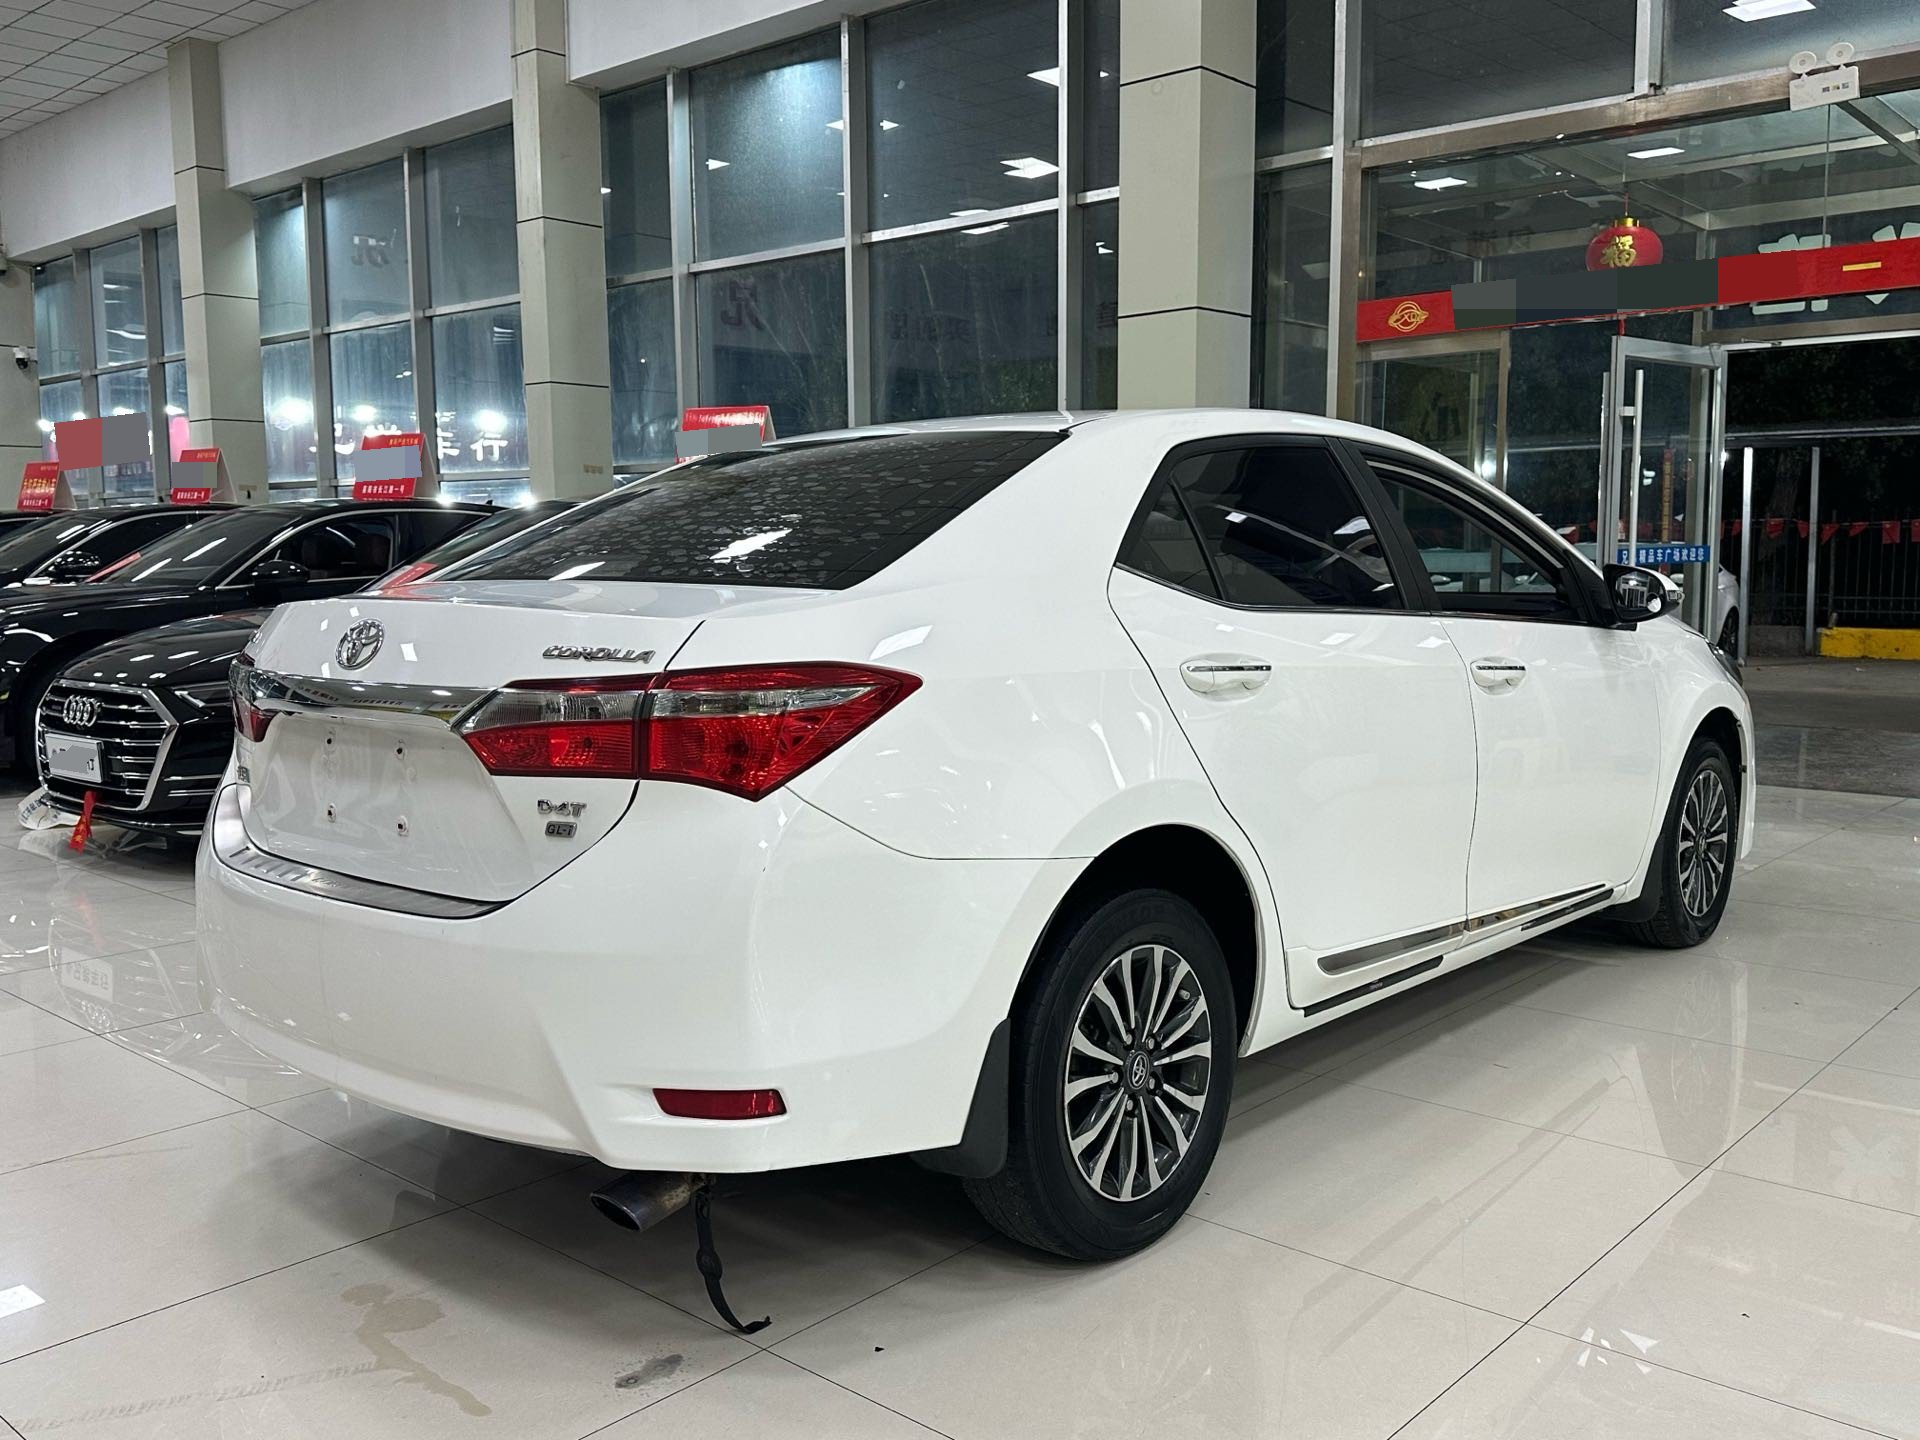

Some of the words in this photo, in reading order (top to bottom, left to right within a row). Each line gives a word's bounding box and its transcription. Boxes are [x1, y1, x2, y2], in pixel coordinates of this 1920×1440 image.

[1622, 547, 1705, 565] 兄精品车广场欢迎您
[542, 645, 656, 664] COROLLA
[537, 799, 587, 817] D-4T
[547, 823, 575, 836] GL-i
